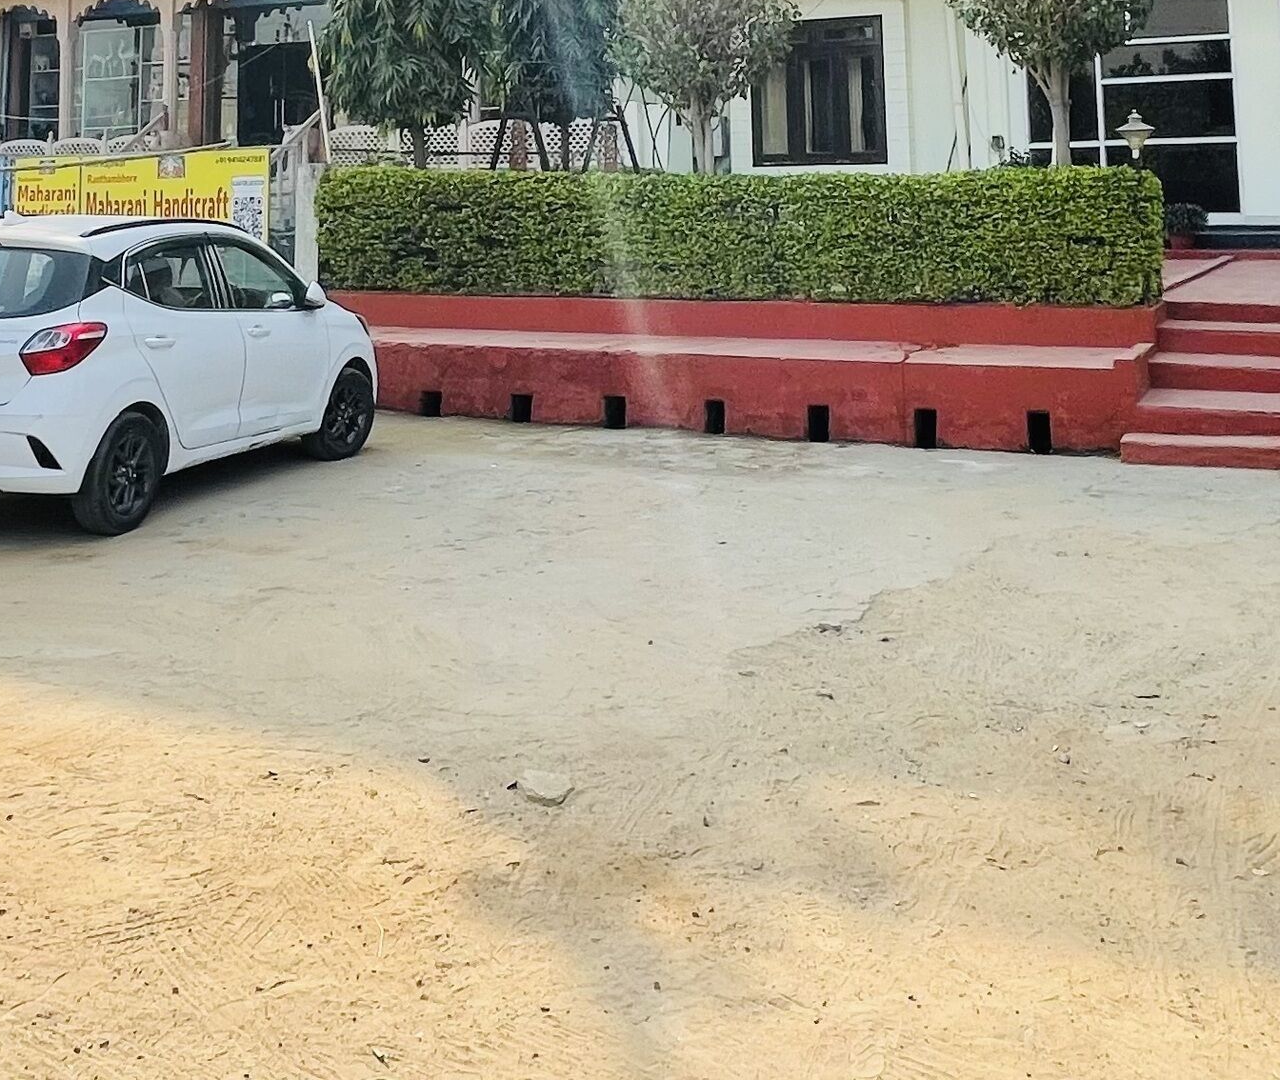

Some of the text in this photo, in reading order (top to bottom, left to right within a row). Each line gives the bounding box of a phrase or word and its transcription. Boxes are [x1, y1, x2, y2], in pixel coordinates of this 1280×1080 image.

[18, 183, 76, 202] Maharani
[86, 187, 229, 219] Maharani Handicraft
